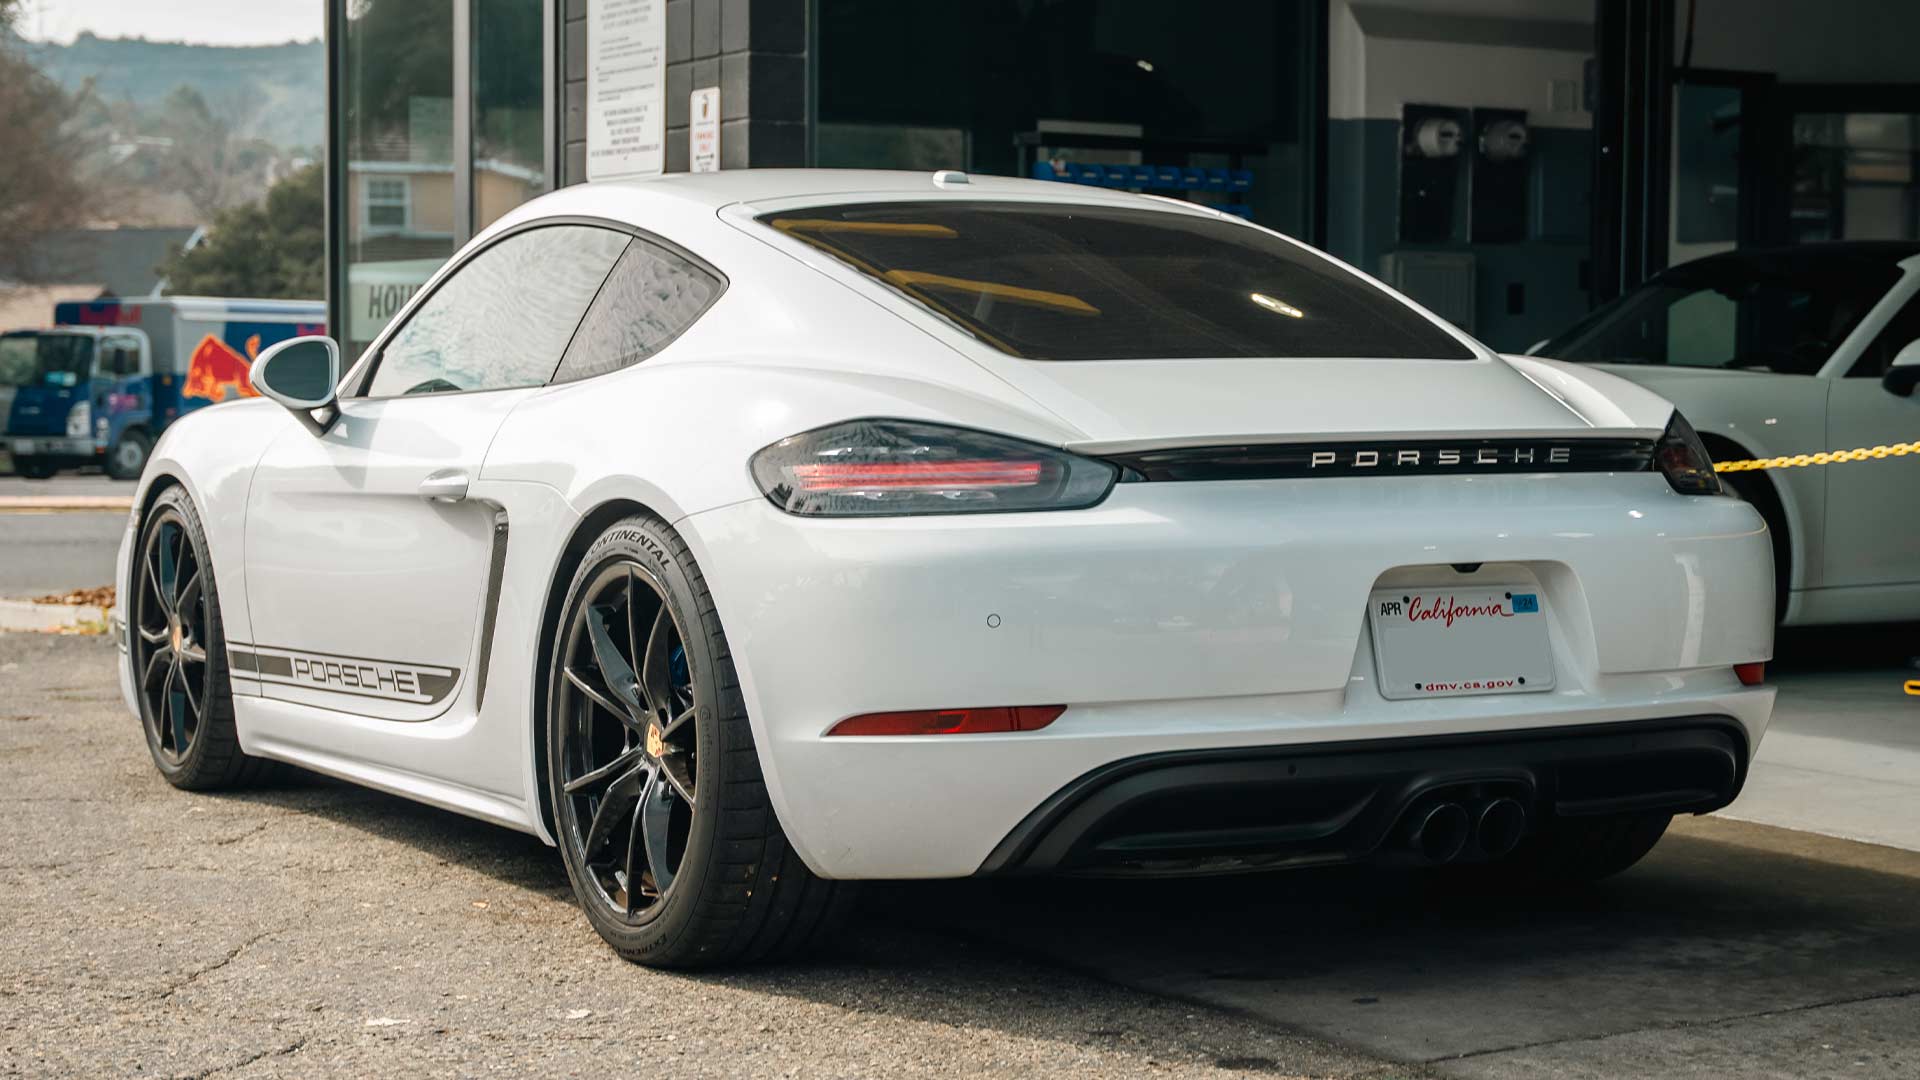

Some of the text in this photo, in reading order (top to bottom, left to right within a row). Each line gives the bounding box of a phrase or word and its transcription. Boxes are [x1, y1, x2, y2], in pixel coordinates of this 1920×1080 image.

[368, 284, 424, 319] HOU
[1311, 447, 1571, 468] PORSCHE
[1380, 596, 1515, 628] APR California
[294, 658, 416, 694] PORSCHE
[1425, 679, 1514, 692] dmv.ca.gov
